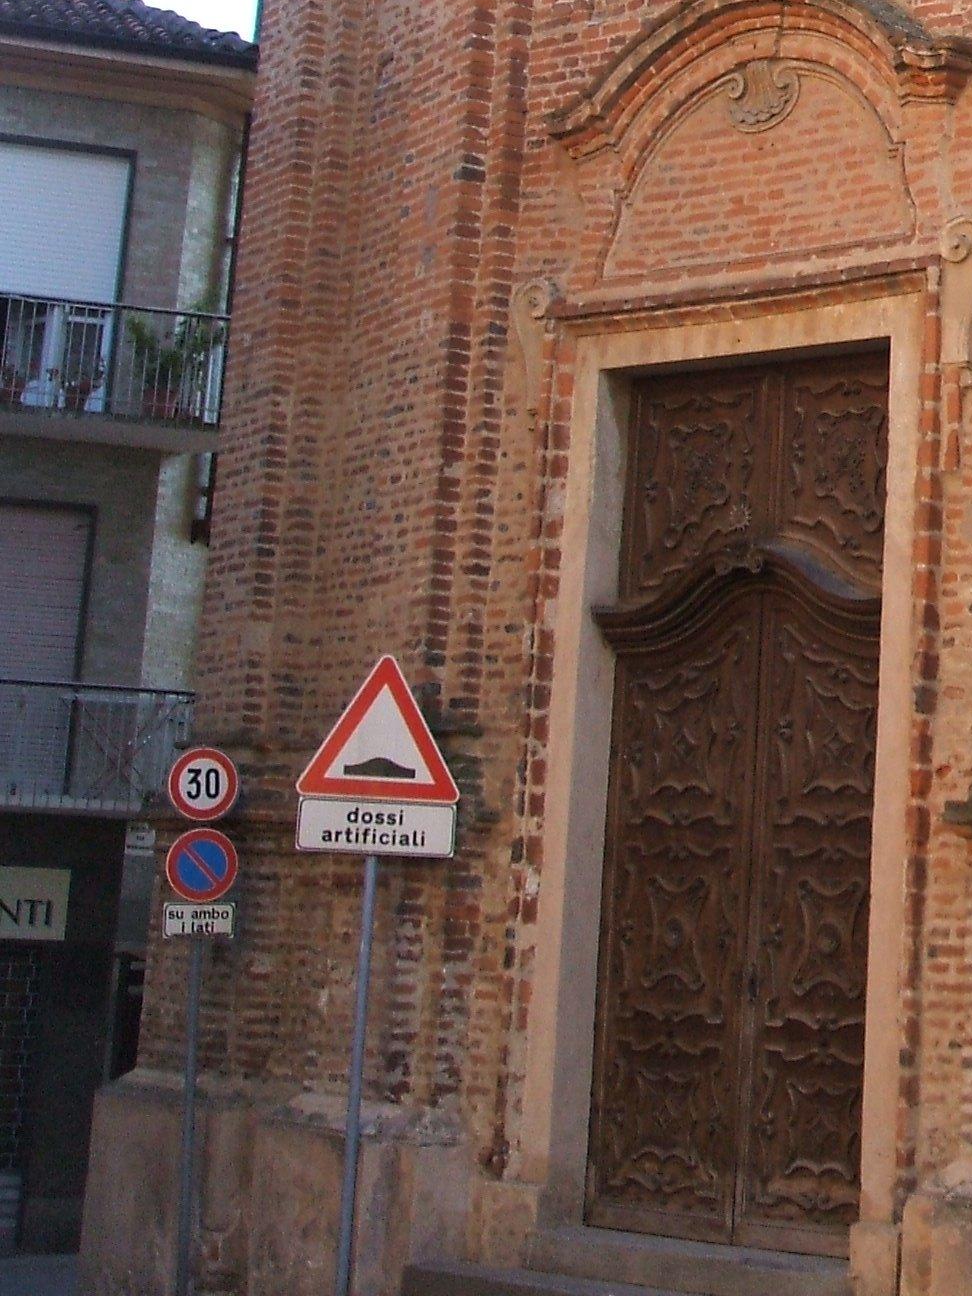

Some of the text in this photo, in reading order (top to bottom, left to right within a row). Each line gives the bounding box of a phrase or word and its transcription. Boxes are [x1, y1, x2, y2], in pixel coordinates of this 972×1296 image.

[186, 767, 221, 800] 30
[346, 806, 404, 826] dossi
[321, 827, 426, 847] artificiali
[168, 907, 230, 920] su ambo
[191, 921, 215, 934] lati
